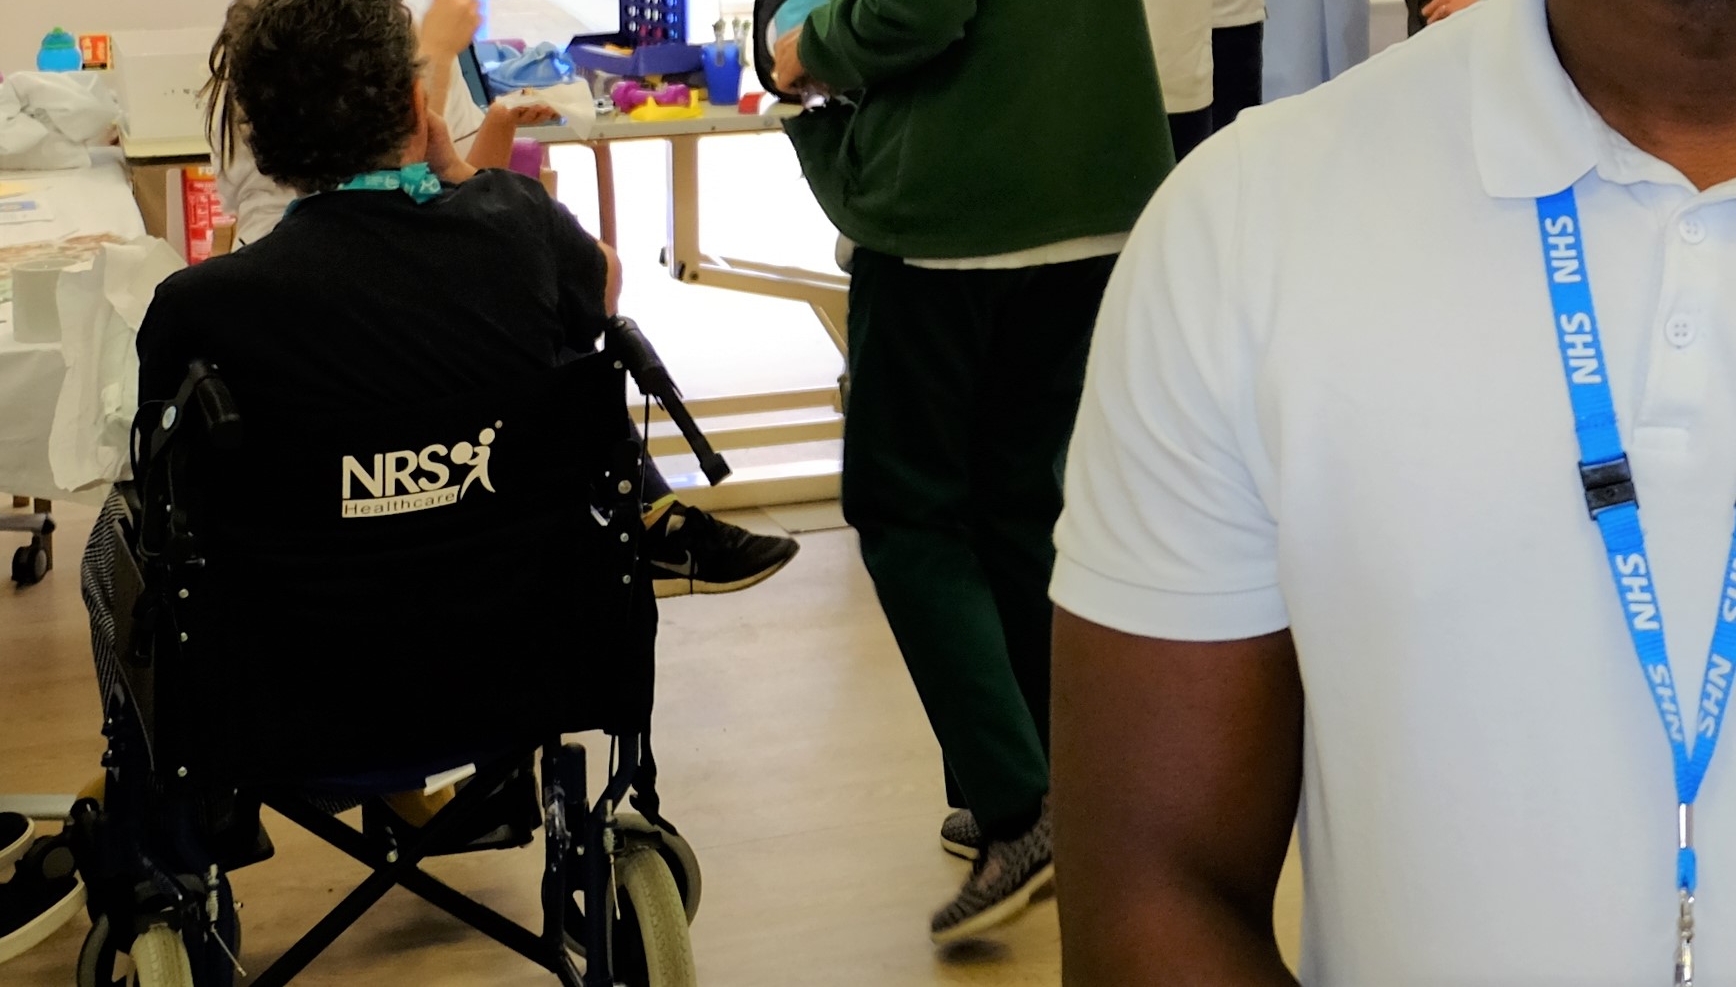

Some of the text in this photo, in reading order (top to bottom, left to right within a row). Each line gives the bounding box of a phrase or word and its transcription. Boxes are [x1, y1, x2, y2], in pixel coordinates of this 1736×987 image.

[1544, 215, 1581, 283] NHS
[1560, 312, 1602, 384] NHS
[342, 443, 450, 499] NRS
[344, 491, 456, 516] Healthcare
[1615, 553, 1660, 630] NHS
[1649, 664, 1683, 742] NHS
[1699, 653, 1732, 738] NHS
